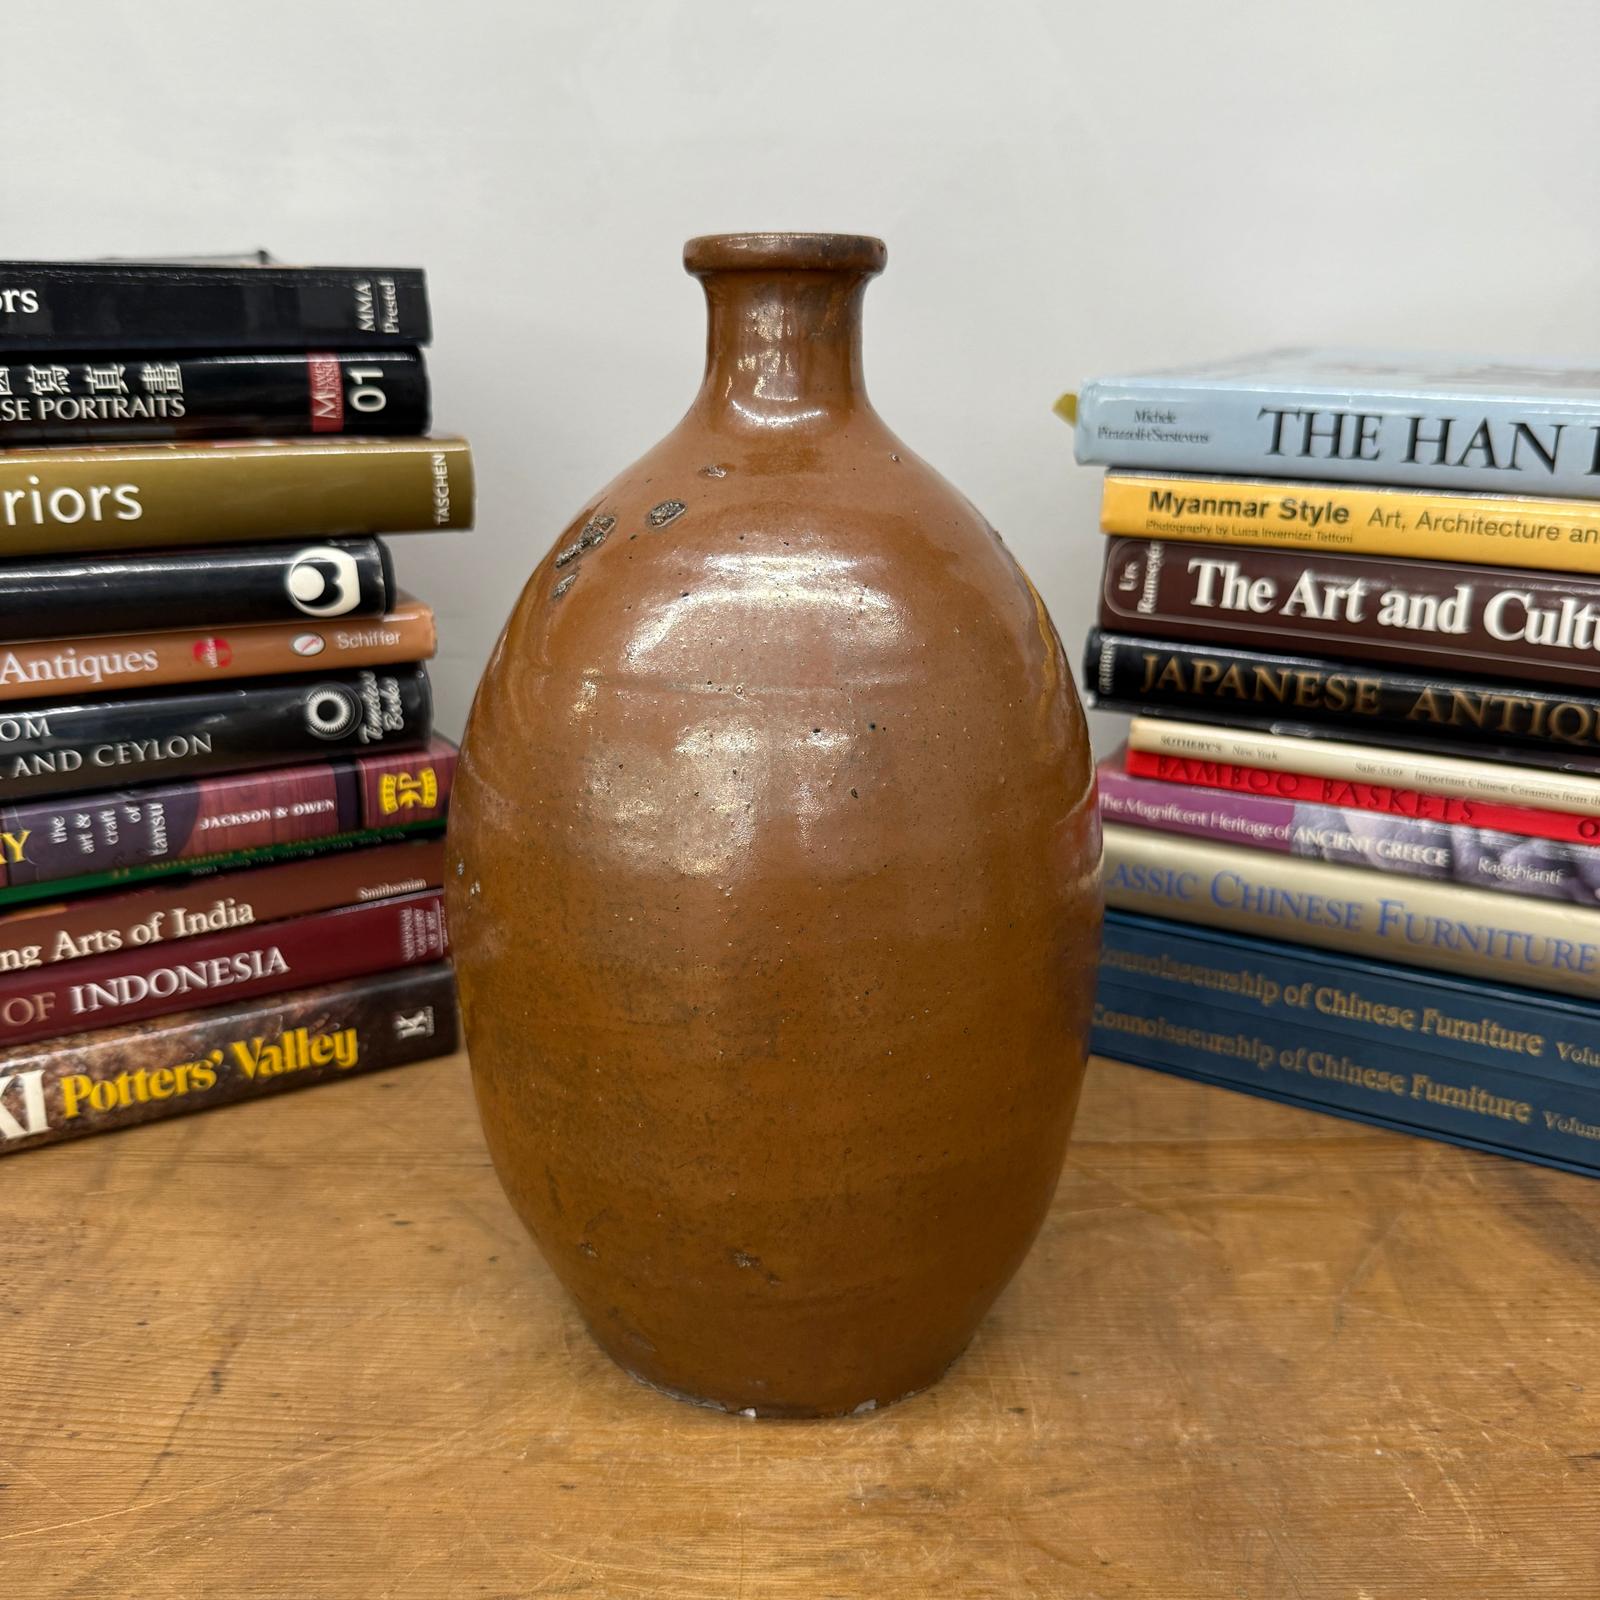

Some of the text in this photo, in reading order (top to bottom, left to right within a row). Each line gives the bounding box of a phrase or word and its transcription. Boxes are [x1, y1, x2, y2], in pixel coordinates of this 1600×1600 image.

[0, 288, 39, 314] rs
[352, 278, 375, 332] MMA
[378, 277, 399, 334] Prestel
[0, 394, 187, 422] SE PORTRAITS
[348, 366, 387, 413] 01
[1257, 404, 1383, 463] THE
[1401, 416, 1569, 475] HAN
[3, 474, 143, 526] riors
[431, 452, 451, 526] TASCHEN
[1149, 489, 1600, 545] Myanmar Style Art, Architecture an
[1215, 525, 1228, 538] by
[1188, 557, 1600, 651] The Art and Cult
[0, 648, 159, 684] Antiques
[337, 631, 401, 650] Schiffer
[1140, 652, 1381, 715] JAPANESE
[1411, 684, 1600, 745] ANTIQ
[0, 718, 52, 742] OM
[12, 732, 213, 778] AND CEYLON
[1156, 754, 1300, 795] BAMBOO
[1321, 779, 1475, 822] BASKETS
[1232, 745, 1253, 757] New
[1256, 748, 1279, 761] York
[1468, 779, 1509, 793] Chinese
[1510, 784, 1560, 800] Ceramics
[1562, 791, 1588, 803] from
[51, 815, 68, 844] the
[75, 813, 95, 854] art &
[99, 808, 119, 846] craft
[124, 805, 142, 824] of
[147, 803, 168, 856] tansu
[200, 800, 335, 830] JACKSON & OWEN
[1124, 798, 1206, 829] Magnificent
[1211, 812, 1272, 840] Heritage
[1273, 823, 1291, 841] of
[1293, 825, 1370, 854] ANCIENT
[1375, 838, 1450, 868] GREECE
[357, 878, 426, 899] Smithsonian
[50, 928, 123, 962] Arts
[127, 911, 165, 945] of
[168, 898, 256, 939] India
[1107, 863, 1600, 974] ASSIC CHINESE FURNITURE
[3, 946, 290, 1026] OF INDONESIA
[1284, 982, 1313, 1008] of
[1315, 986, 1416, 1031] Chinese
[1420, 1007, 1545, 1056] Furniture
[60, 1049, 224, 1120] Potters'
[230, 1027, 359, 1080] Valley
[1279, 1047, 1308, 1072] of
[1307, 1051, 1406, 1096] Chinese
[1409, 1073, 1533, 1125] Furniture
